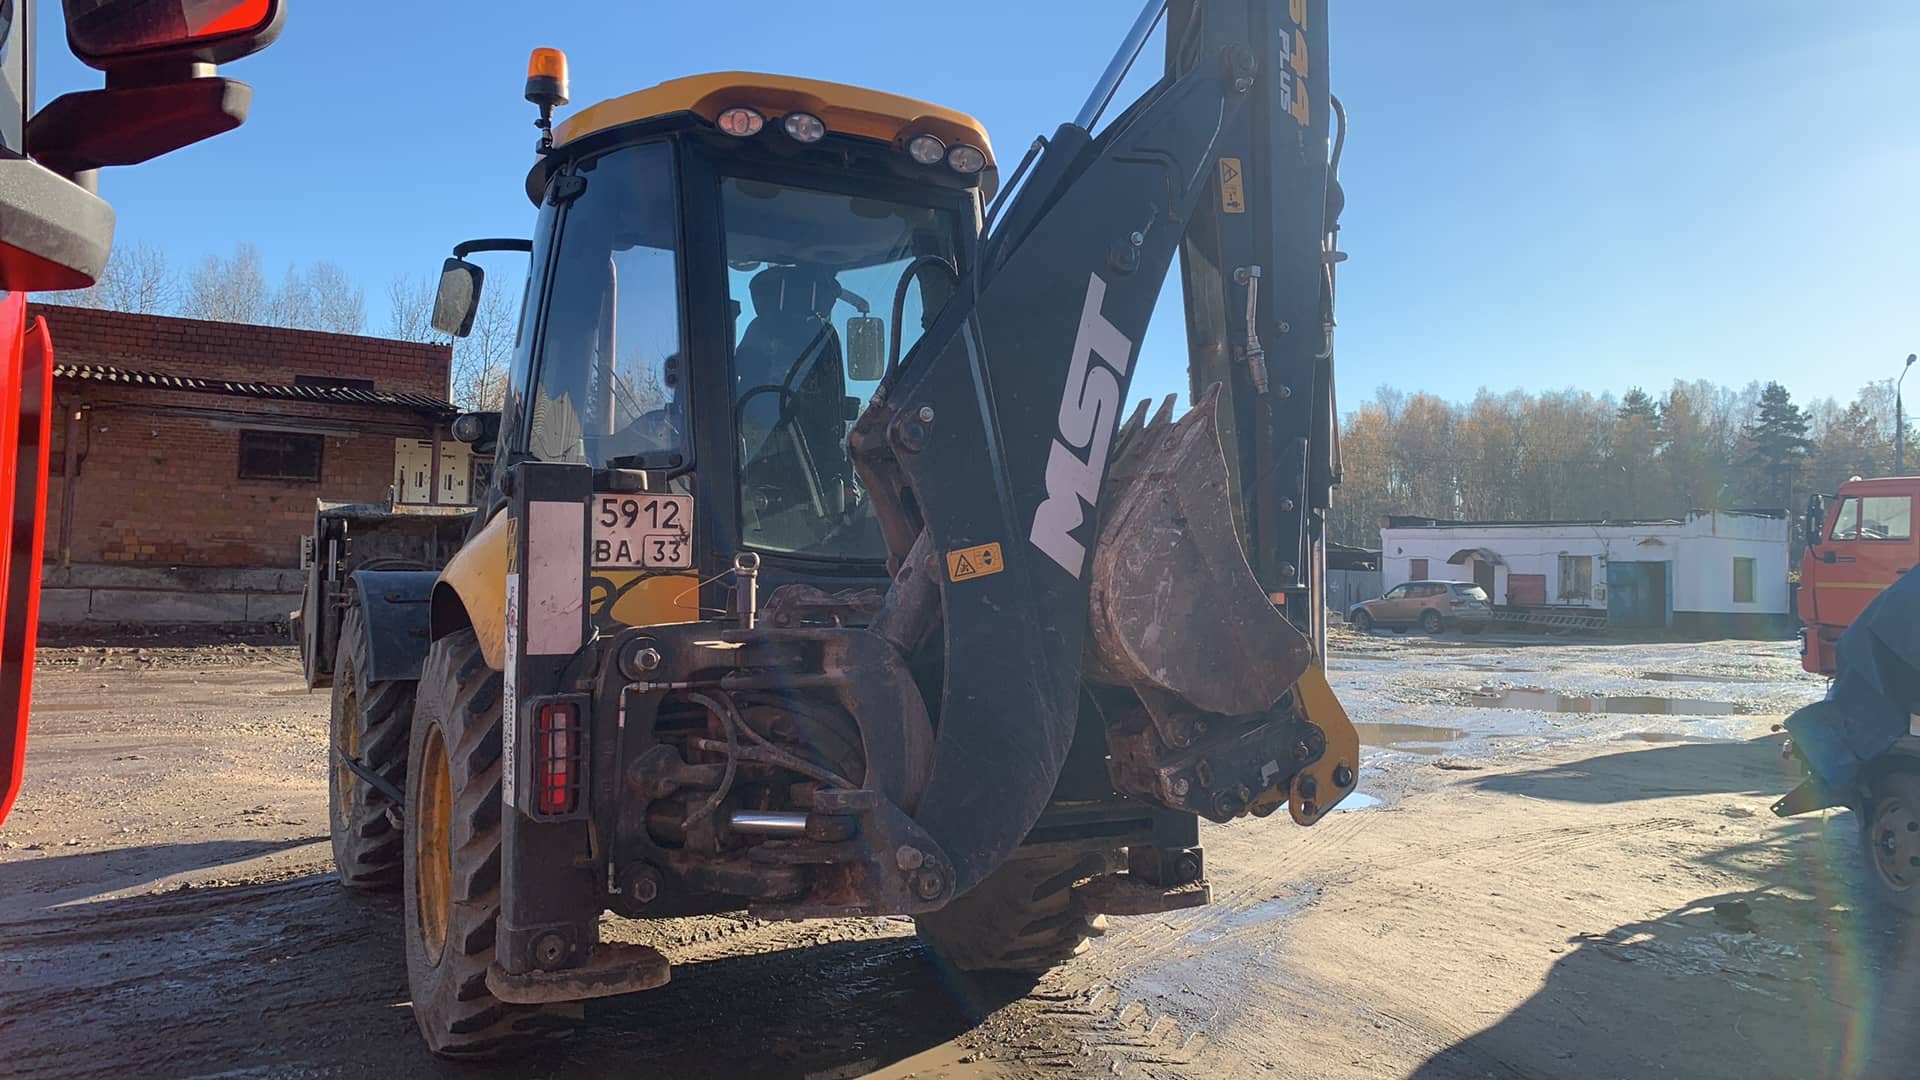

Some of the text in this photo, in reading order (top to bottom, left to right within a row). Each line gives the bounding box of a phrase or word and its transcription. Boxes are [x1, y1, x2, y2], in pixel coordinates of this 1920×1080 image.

[1279, 28, 1292, 114] PLUS
[1029, 271, 1132, 579] MST
[600, 498, 680, 529] 5912
[595, 539, 681, 562] ВА 33
